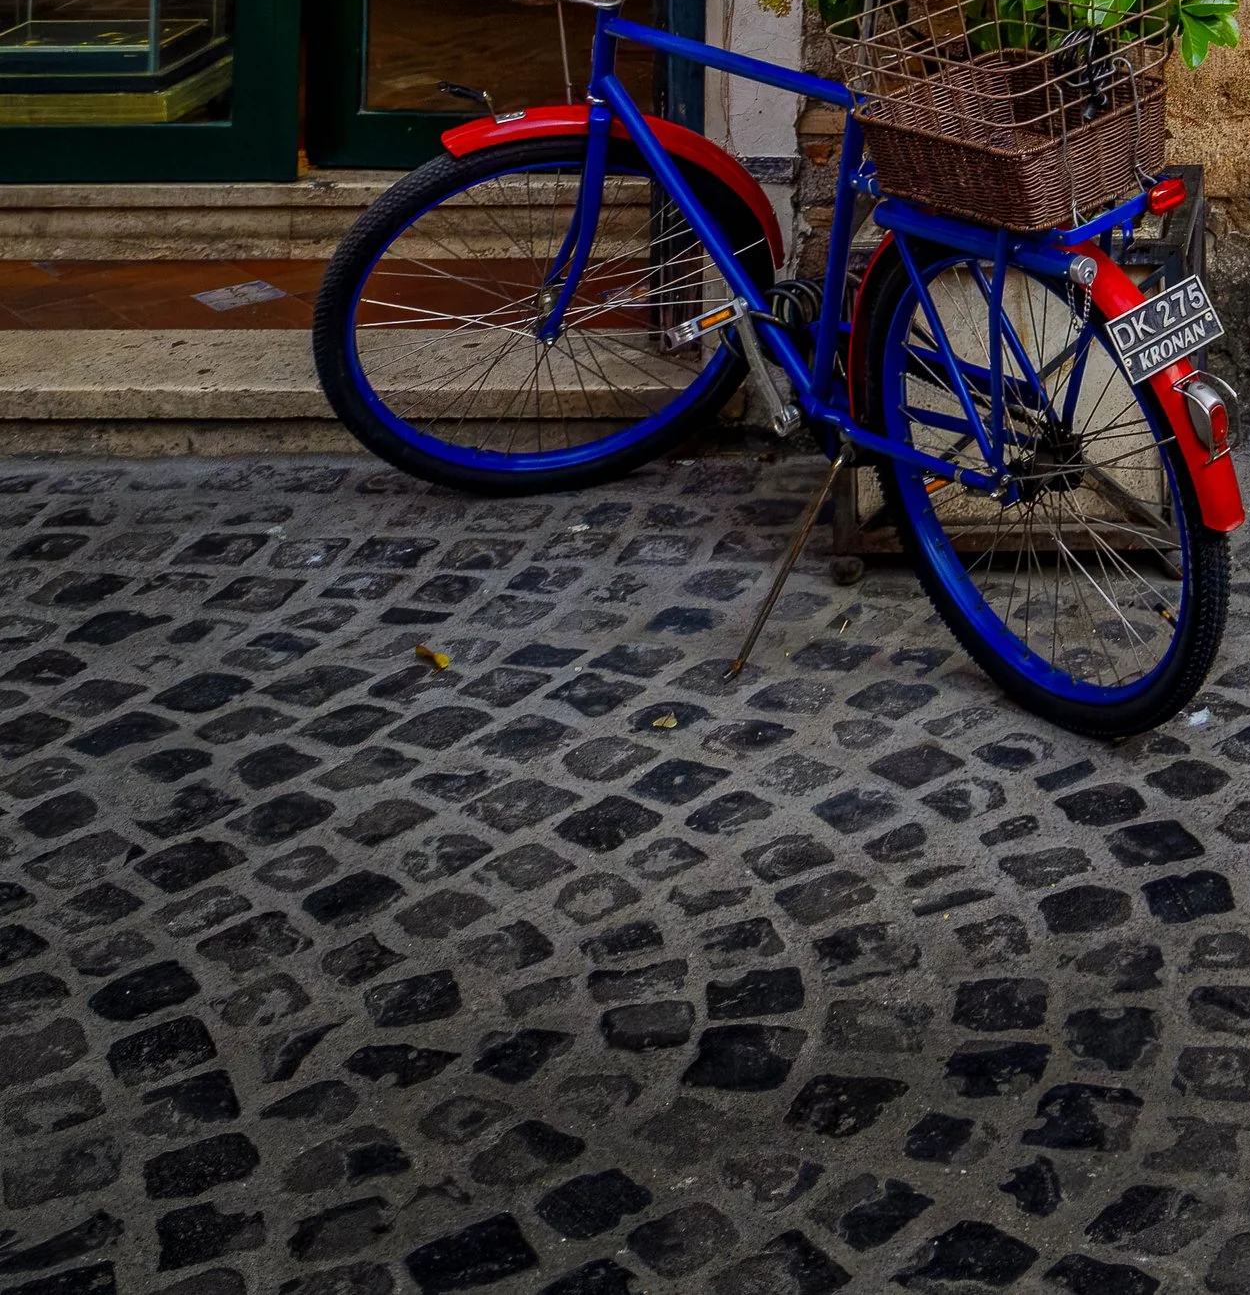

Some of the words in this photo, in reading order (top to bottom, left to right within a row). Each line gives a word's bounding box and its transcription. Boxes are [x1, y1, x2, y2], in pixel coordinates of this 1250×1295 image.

[1111, 310, 1156, 351] DK
[1155, 282, 1206, 329] 275
[1138, 319, 1207, 371] KRONAN
